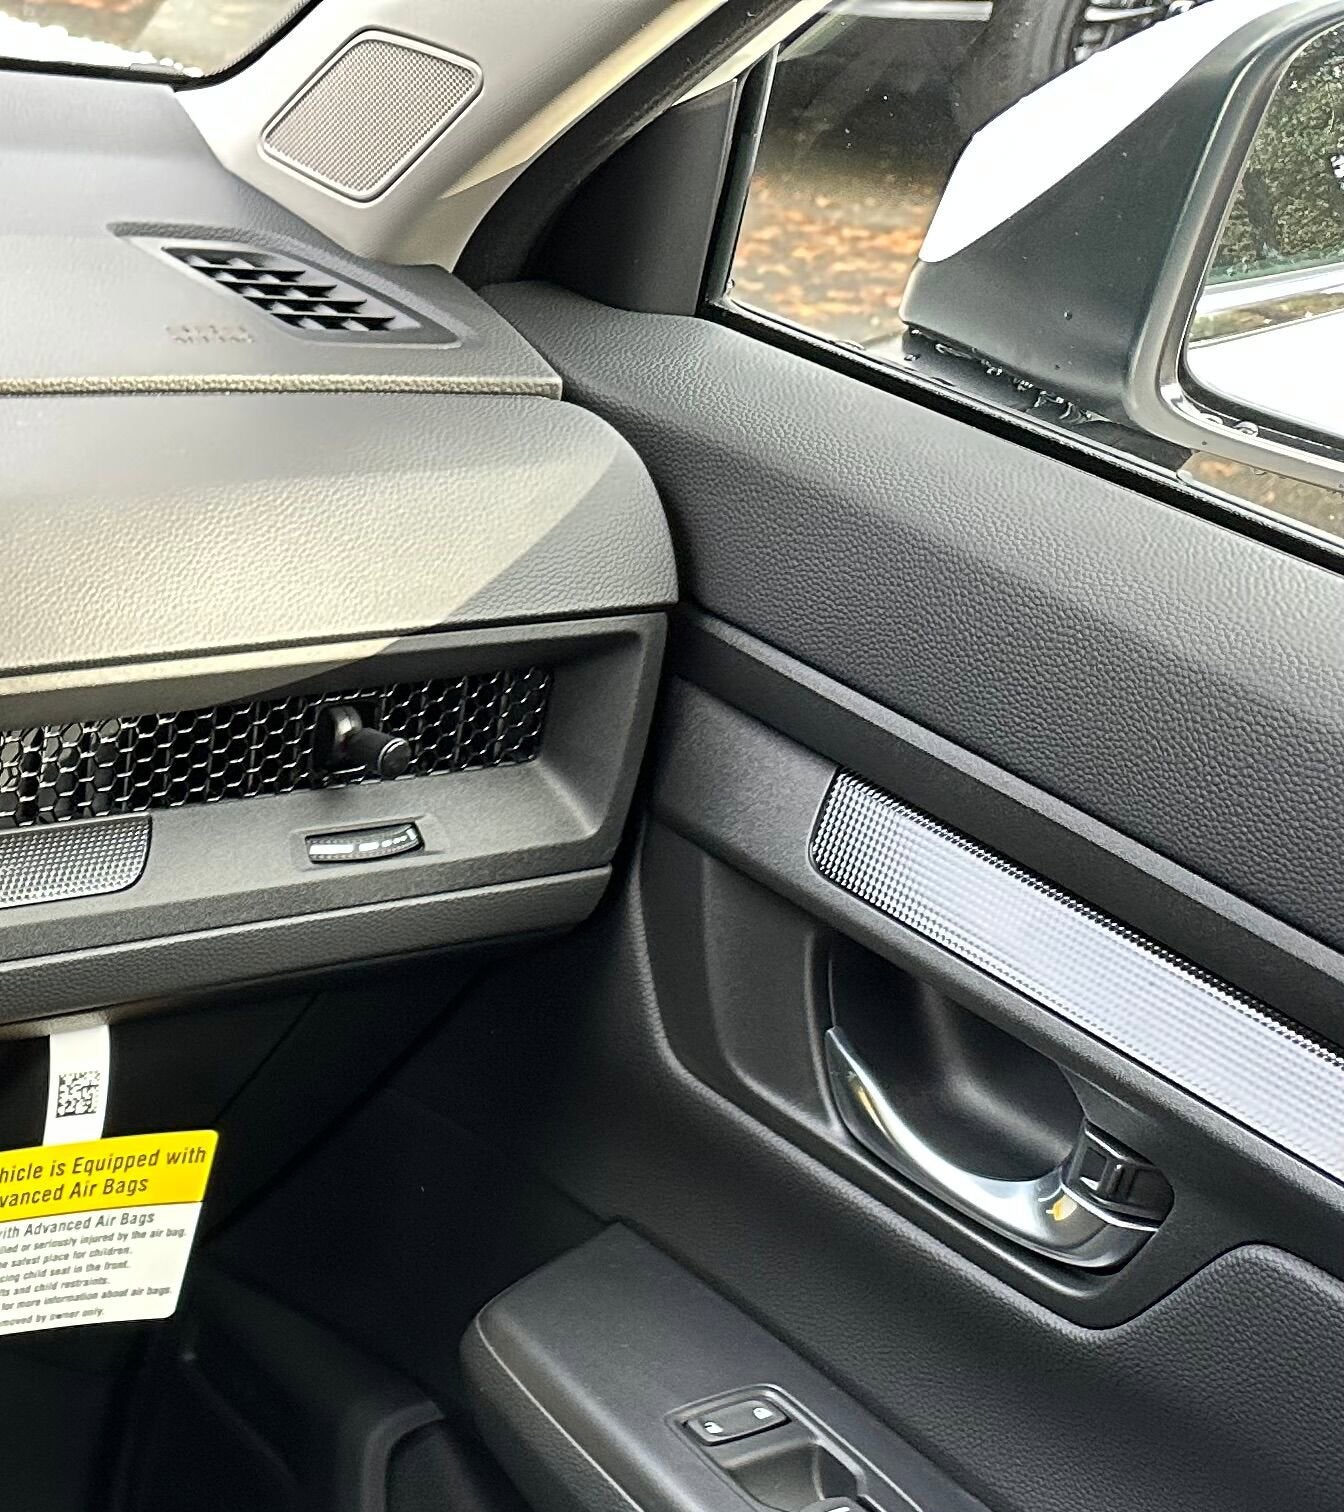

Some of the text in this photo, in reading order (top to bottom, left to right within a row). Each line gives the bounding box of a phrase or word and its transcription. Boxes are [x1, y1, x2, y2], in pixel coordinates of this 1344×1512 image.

[50, 1160, 65, 1177] is
[72, 1149, 160, 1176] Equipped
[166, 1146, 206, 1165] with
[69, 1181, 97, 1199] Air
[103, 1177, 149, 1195] Bags
[24, 1216, 92, 1237] Advanced
[95, 1215, 116, 1228] Air
[120, 1213, 154, 1226] Bags
